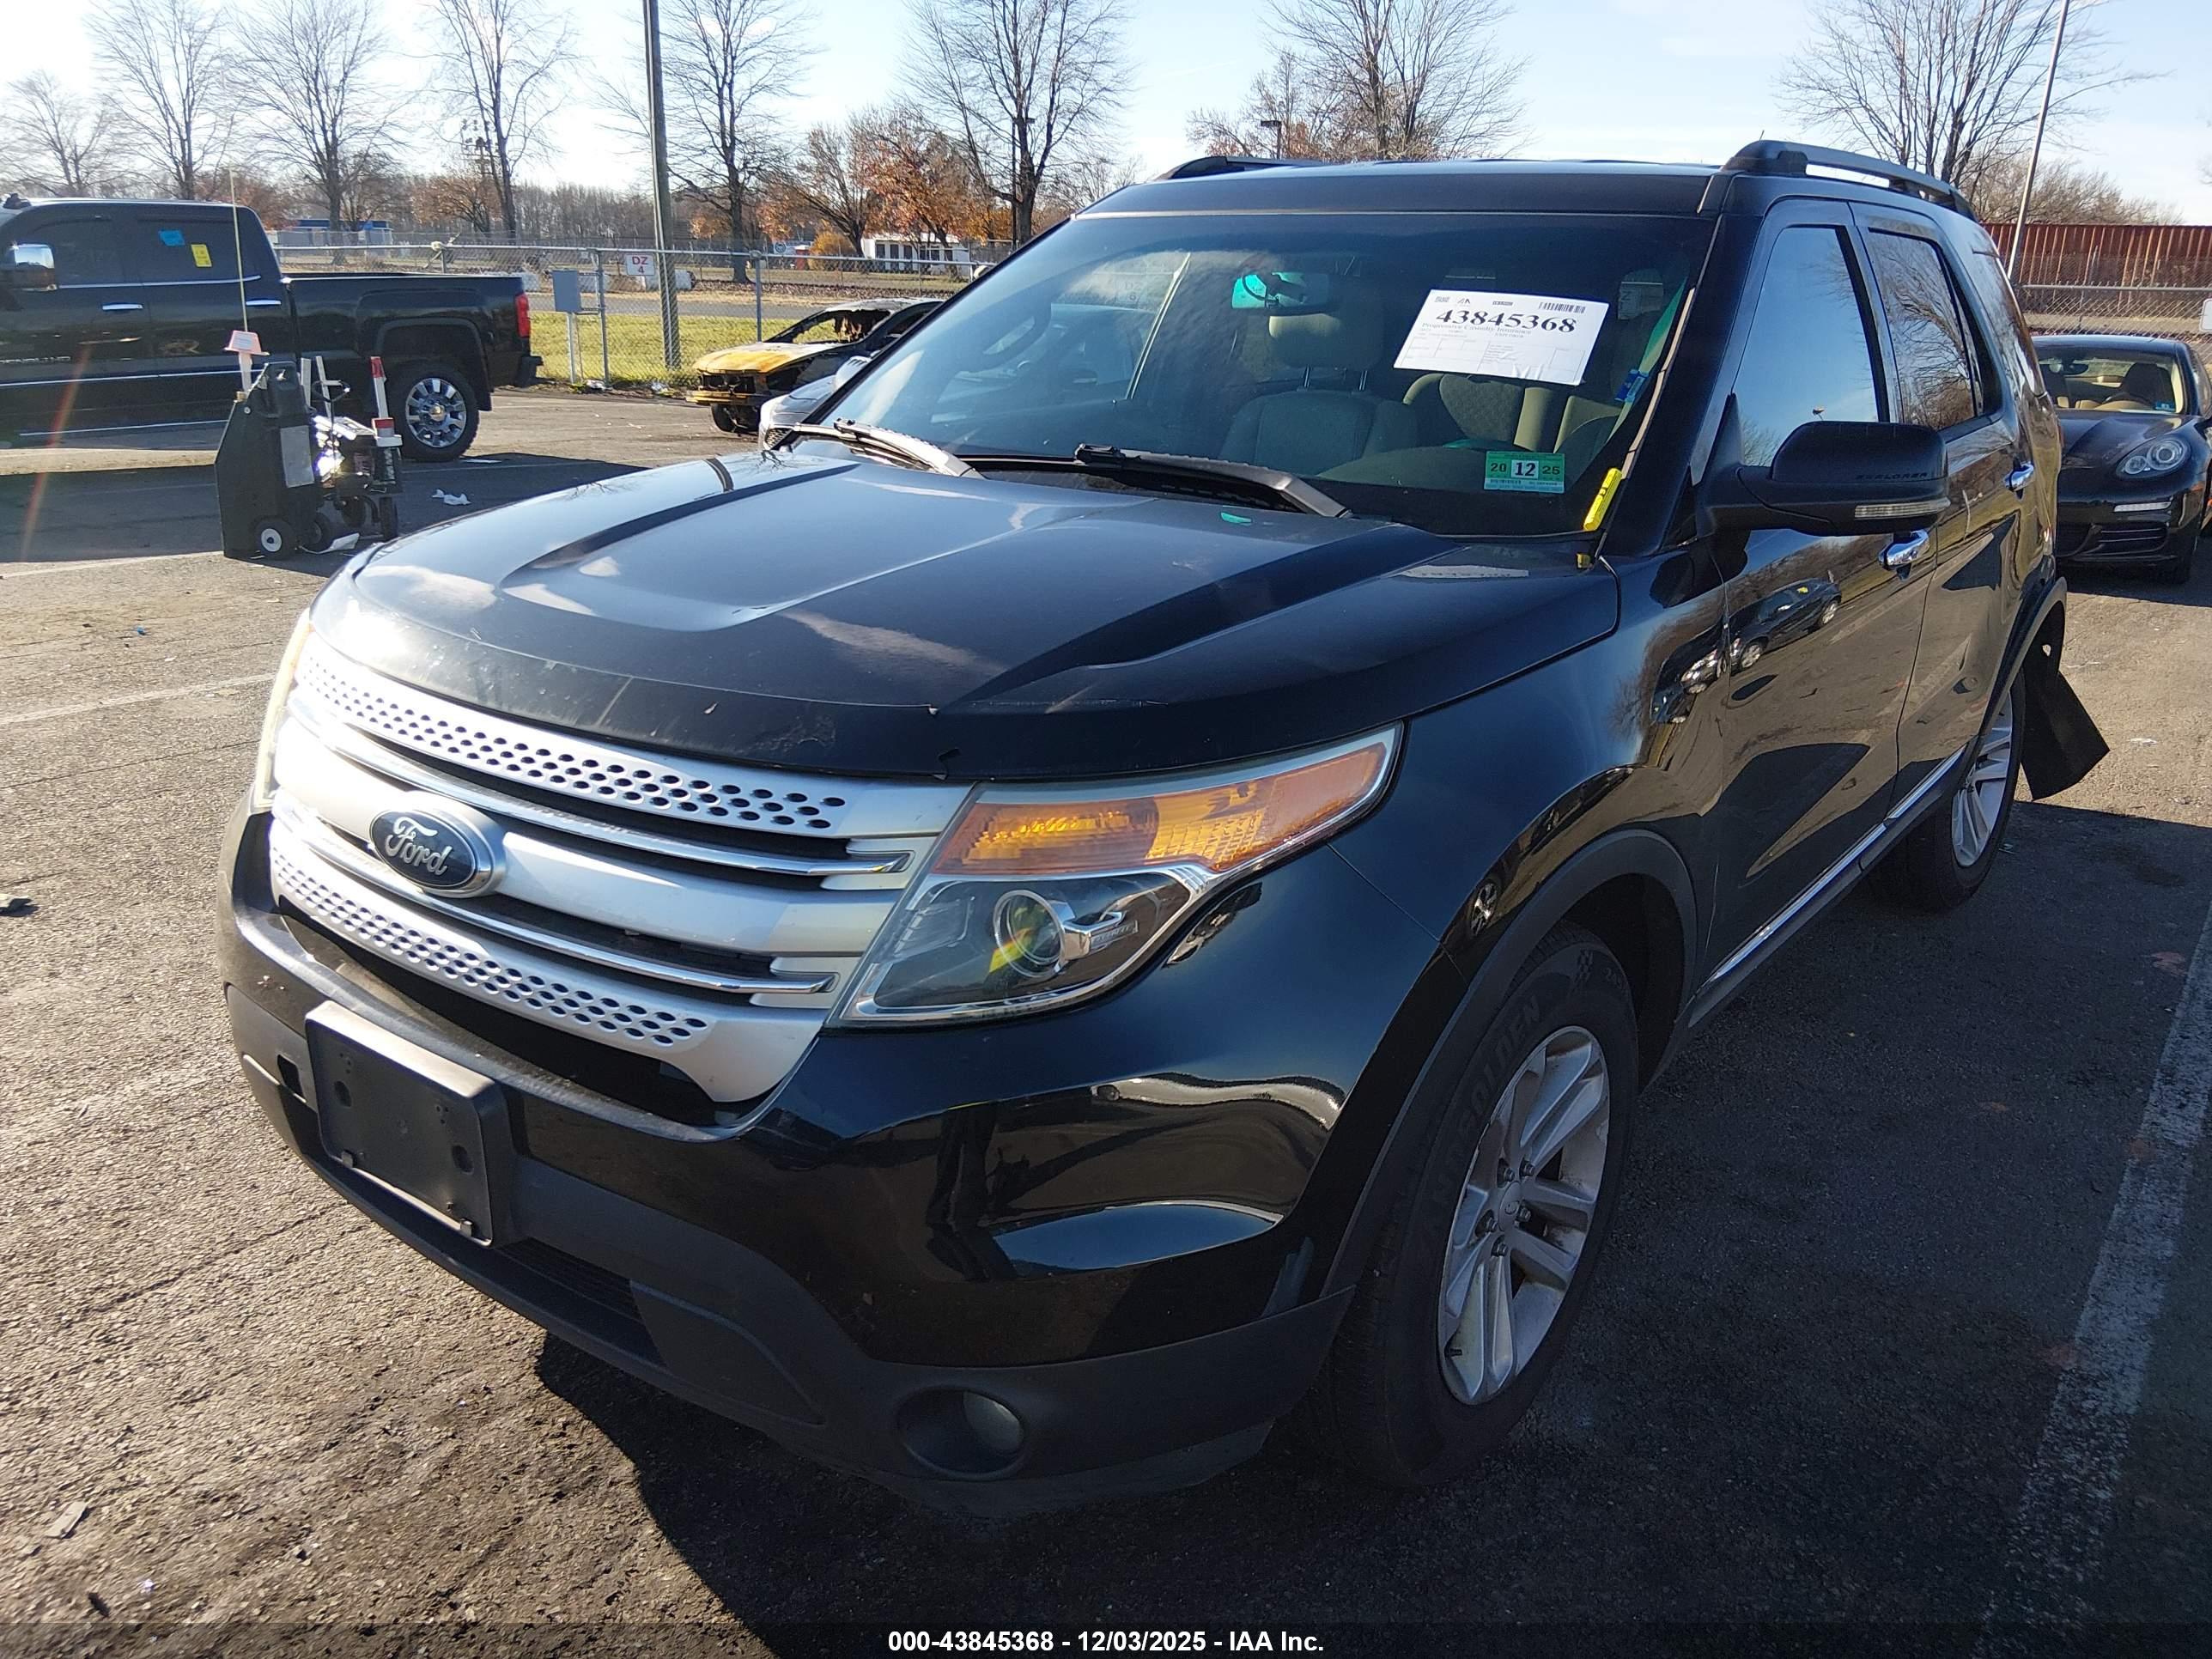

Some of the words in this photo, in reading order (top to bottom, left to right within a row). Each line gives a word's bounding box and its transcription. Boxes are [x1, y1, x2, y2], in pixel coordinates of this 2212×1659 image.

[631, 256, 648, 265] DZ
[638, 265, 645, 274] 4
[1436, 308, 1578, 333] 43845368
[1490, 462, 1507, 472] 20
[1515, 462, 1536, 477] 12
[1542, 465, 1561, 475] 25
[385, 816, 454, 876] Ford
